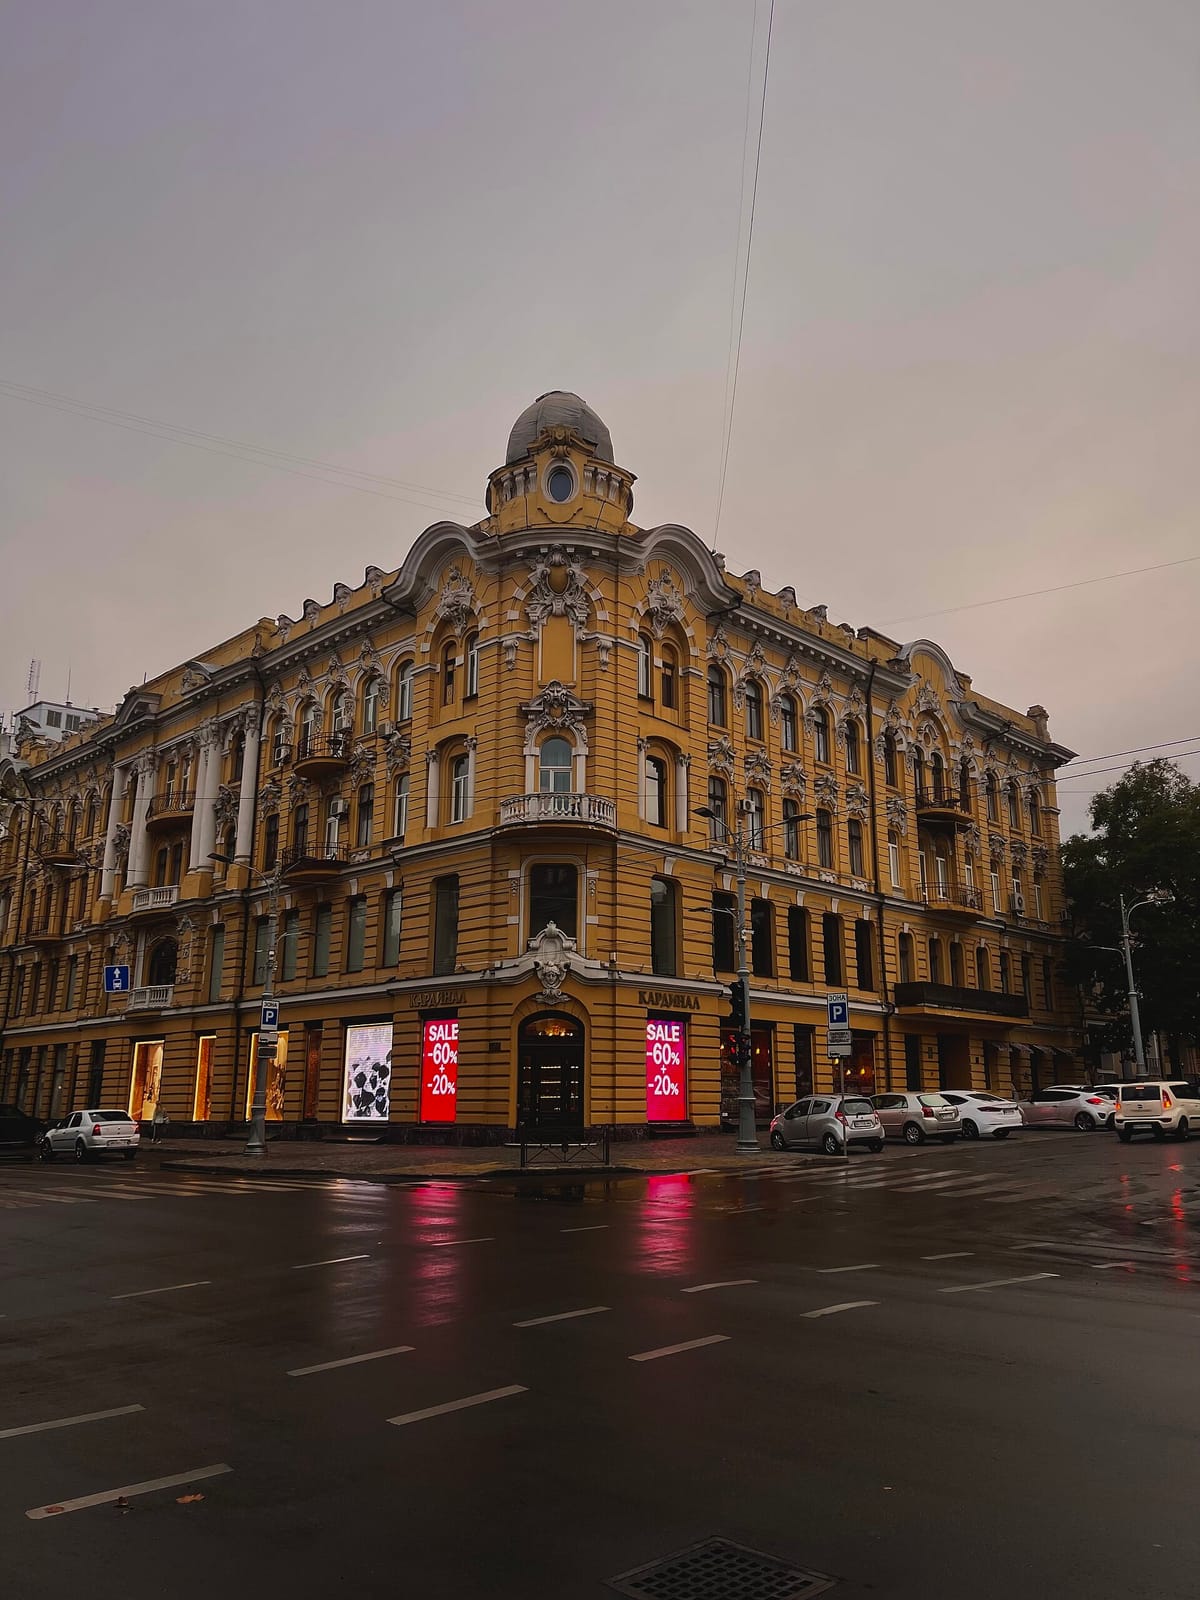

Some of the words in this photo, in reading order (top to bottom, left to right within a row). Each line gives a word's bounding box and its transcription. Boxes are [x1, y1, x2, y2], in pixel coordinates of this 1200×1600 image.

[829, 994, 846, 1002] ЗОНА
[265, 1010, 274, 1022] P
[833, 1005, 843, 1020] P
[429, 1023, 459, 1042] SALE
[646, 1023, 680, 1042] SALE
[428, 1042, 458, 1065] -60%
[646, 1042, 680, 1065] -60%
[427, 1074, 456, 1095] -20%
[648, 1074, 679, 1096] -20%
